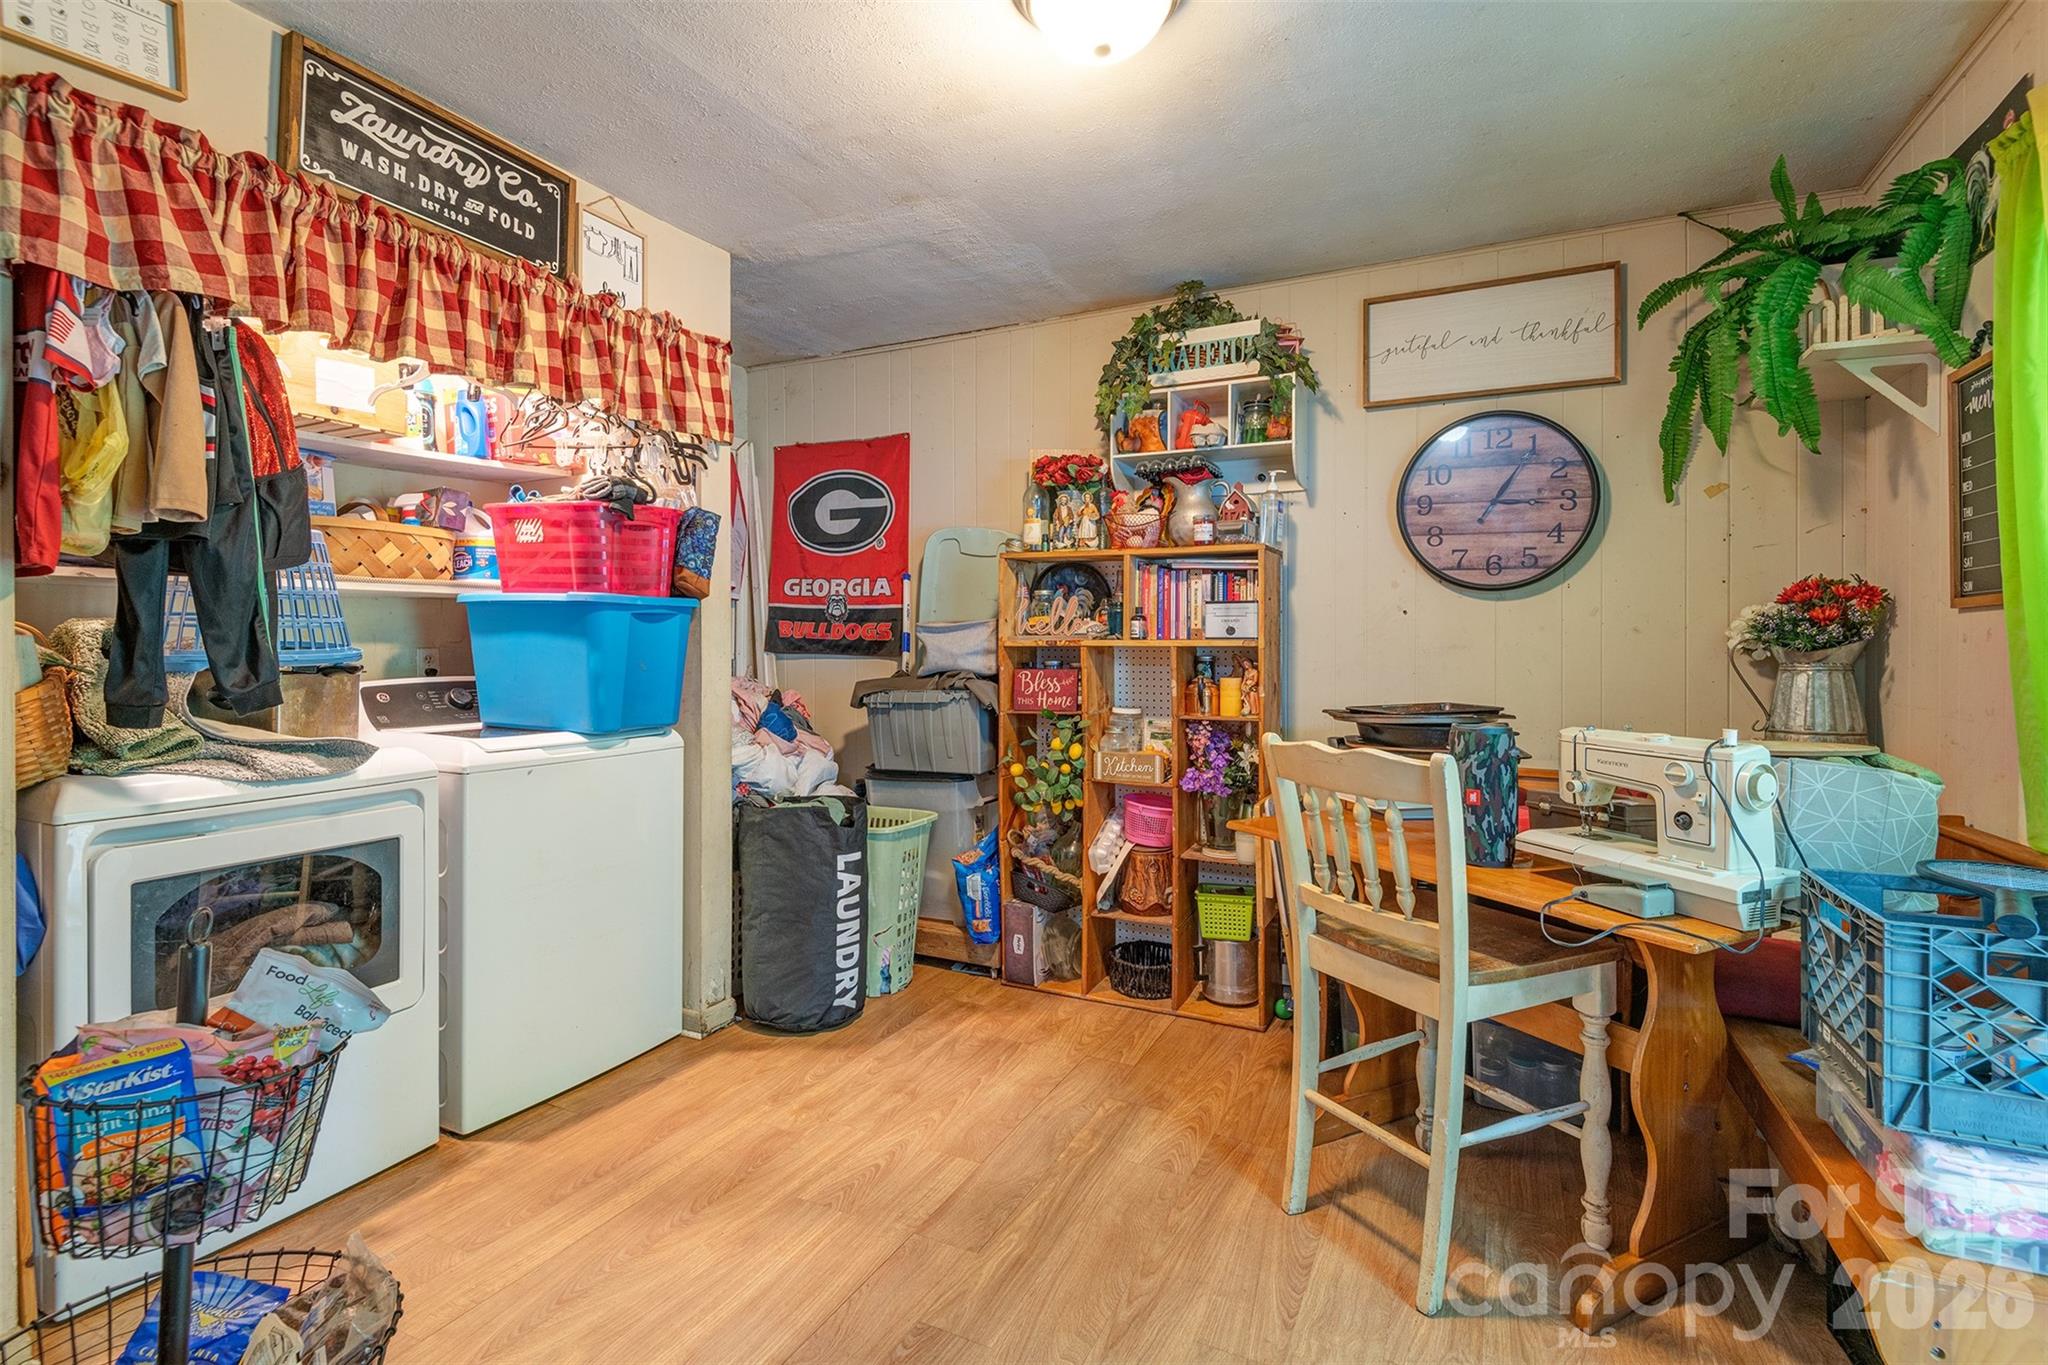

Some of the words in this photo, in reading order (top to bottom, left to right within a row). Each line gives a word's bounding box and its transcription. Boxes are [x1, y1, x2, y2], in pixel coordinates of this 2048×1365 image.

[330, 91, 491, 189] Laundry
[494, 164, 542, 213] Co.
[418, 173, 460, 205] DRY
[463, 198, 485, 215] and
[488, 205, 536, 240] FOLD
[421, 198, 440, 213] EST
[1369, 330, 1467, 364] grateful
[1469, 326, 1502, 348] and
[1510, 312, 1616, 344] thankful
[1453, 436, 1473, 458] 11
[1483, 427, 1513, 450] 12
[1528, 434, 1537, 456] 1
[1961, 431, 1972, 443] MON
[1550, 457, 1568, 479] 2
[1962, 456, 1972, 469] TUE
[1424, 464, 1453, 486] 10
[1962, 480, 1973, 492] WED
[1416, 495, 1433, 516] 9
[1559, 489, 1578, 511] 3
[788, 469, 896, 556] G
[1963, 506, 1974, 518] THU
[1426, 526, 1443, 547] 8
[1546, 522, 1566, 544] 4
[1963, 531, 1973, 542] FRI
[1451, 549, 1469, 569] 7
[1485, 555, 1503, 577] 6
[1520, 547, 1539, 569] 5
[1963, 556, 1973, 568] SAT
[783, 578, 892, 598] GEORGIA
[1963, 581, 1973, 592] SUN
[1016, 596, 1089, 638] hello
[778, 620, 893, 641] BULLDOGS
[1017, 670, 1061, 695] Bless
[1017, 697, 1034, 705] THIS
[1036, 691, 1074, 709] Home
[1103, 756, 1154, 776] Kitchen
[1597, 759, 1629, 769] Kenmore
[833, 851, 862, 1009] LAUNDRY
[266, 965, 308, 986] Food
[80, 1063, 173, 1099] StarKist
[138, 1346, 220, 1363] CANIA
